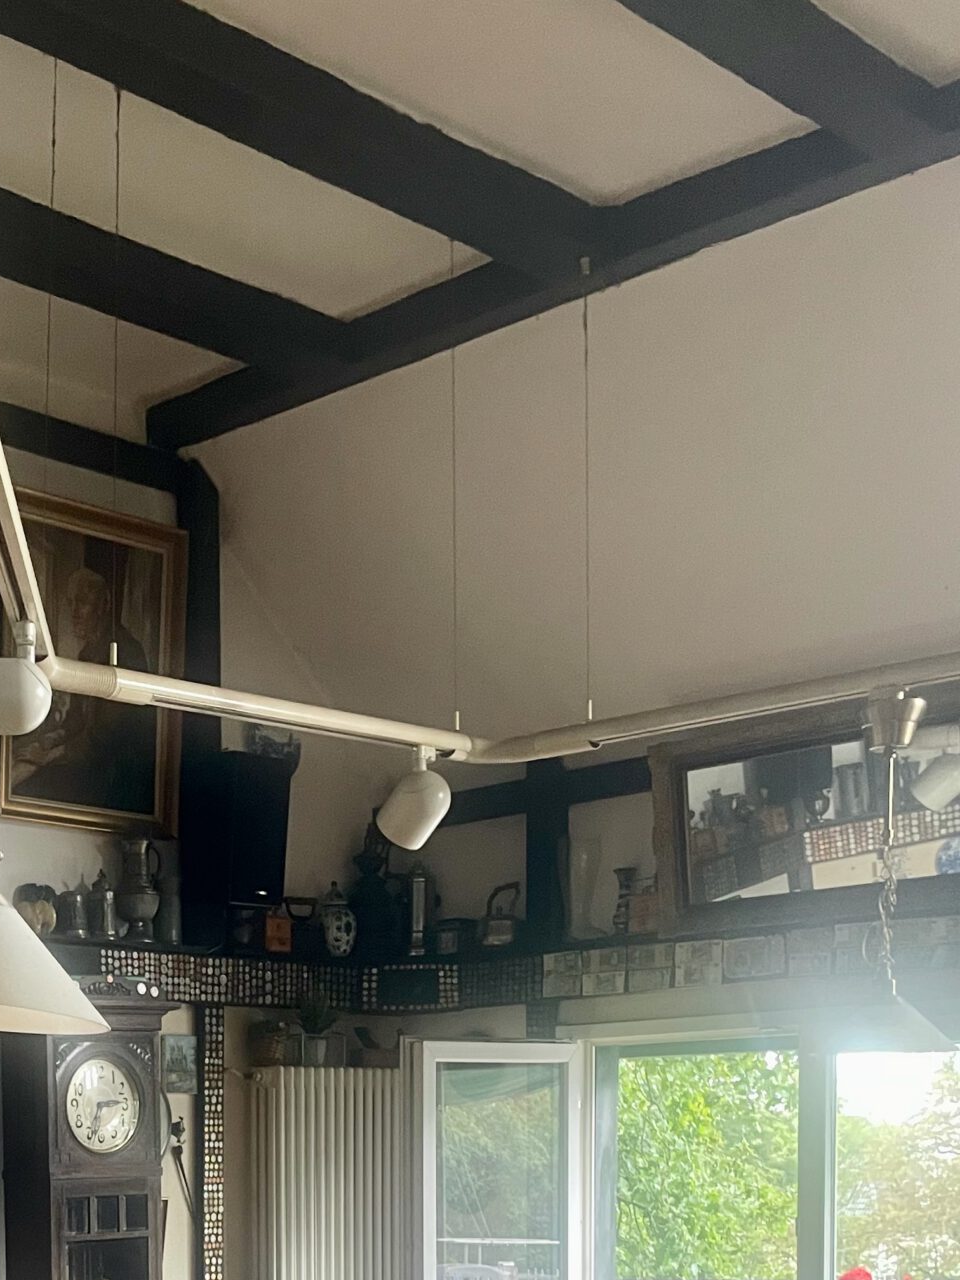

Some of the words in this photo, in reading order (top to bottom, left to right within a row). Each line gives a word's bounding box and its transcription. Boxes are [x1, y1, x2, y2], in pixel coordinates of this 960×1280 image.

[73, 1082, 84, 1097] 10
[118, 1081, 125, 1095] 2
[70, 1098, 79, 1112] 9
[121, 1097, 129, 1111] 3
[75, 1114, 84, 1129] 8
